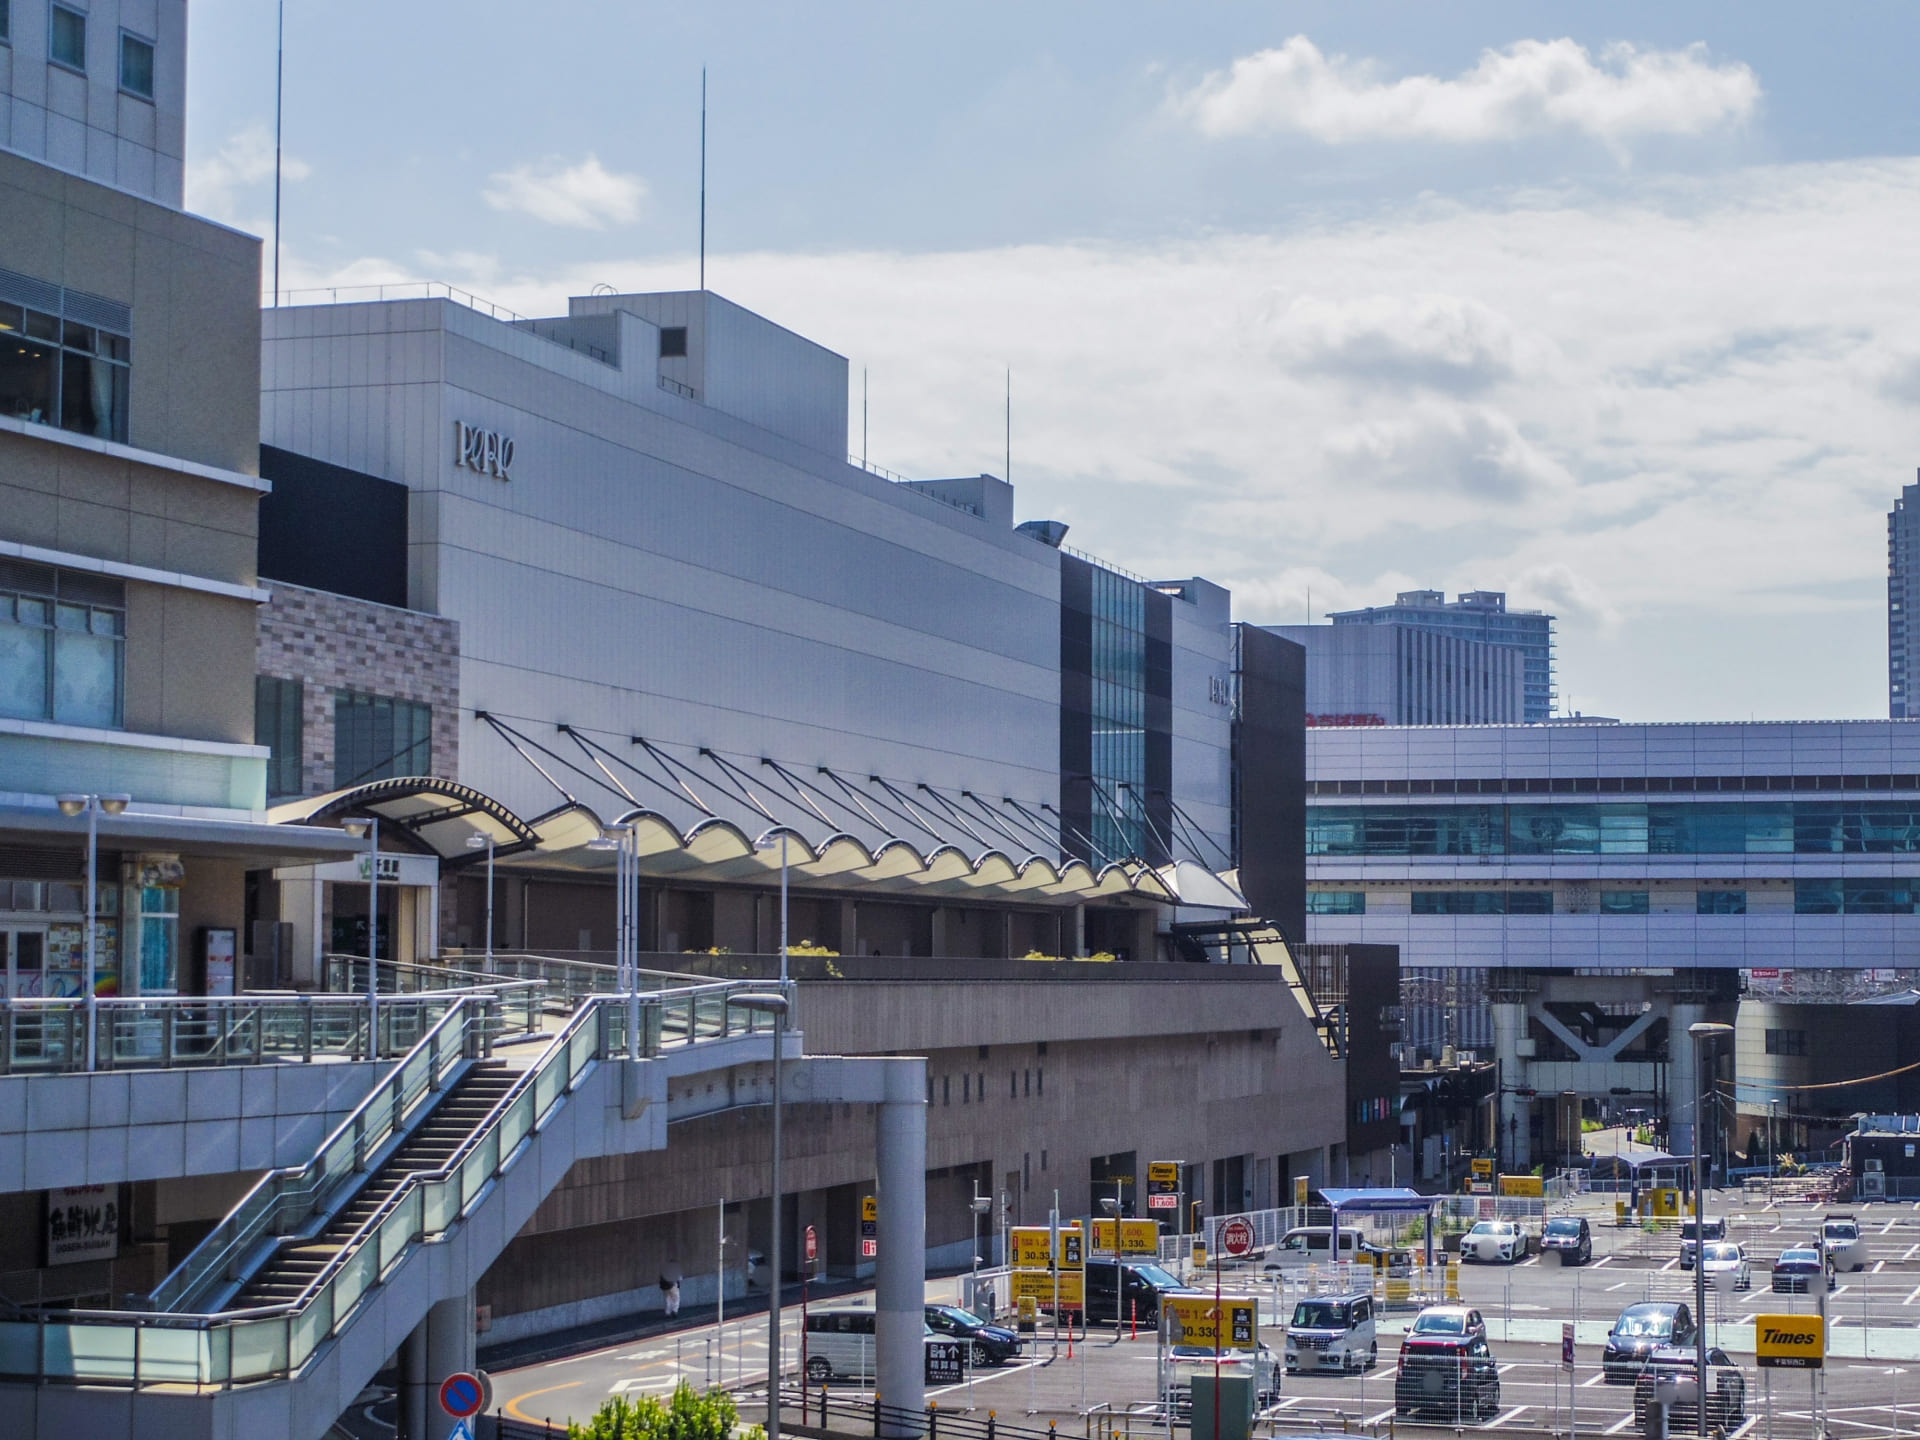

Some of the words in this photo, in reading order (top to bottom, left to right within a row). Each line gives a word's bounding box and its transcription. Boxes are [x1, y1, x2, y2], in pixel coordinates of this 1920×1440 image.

[1226, 1231, 1249, 1245] 消火栓
[1763, 1328, 1816, 1345] Times
